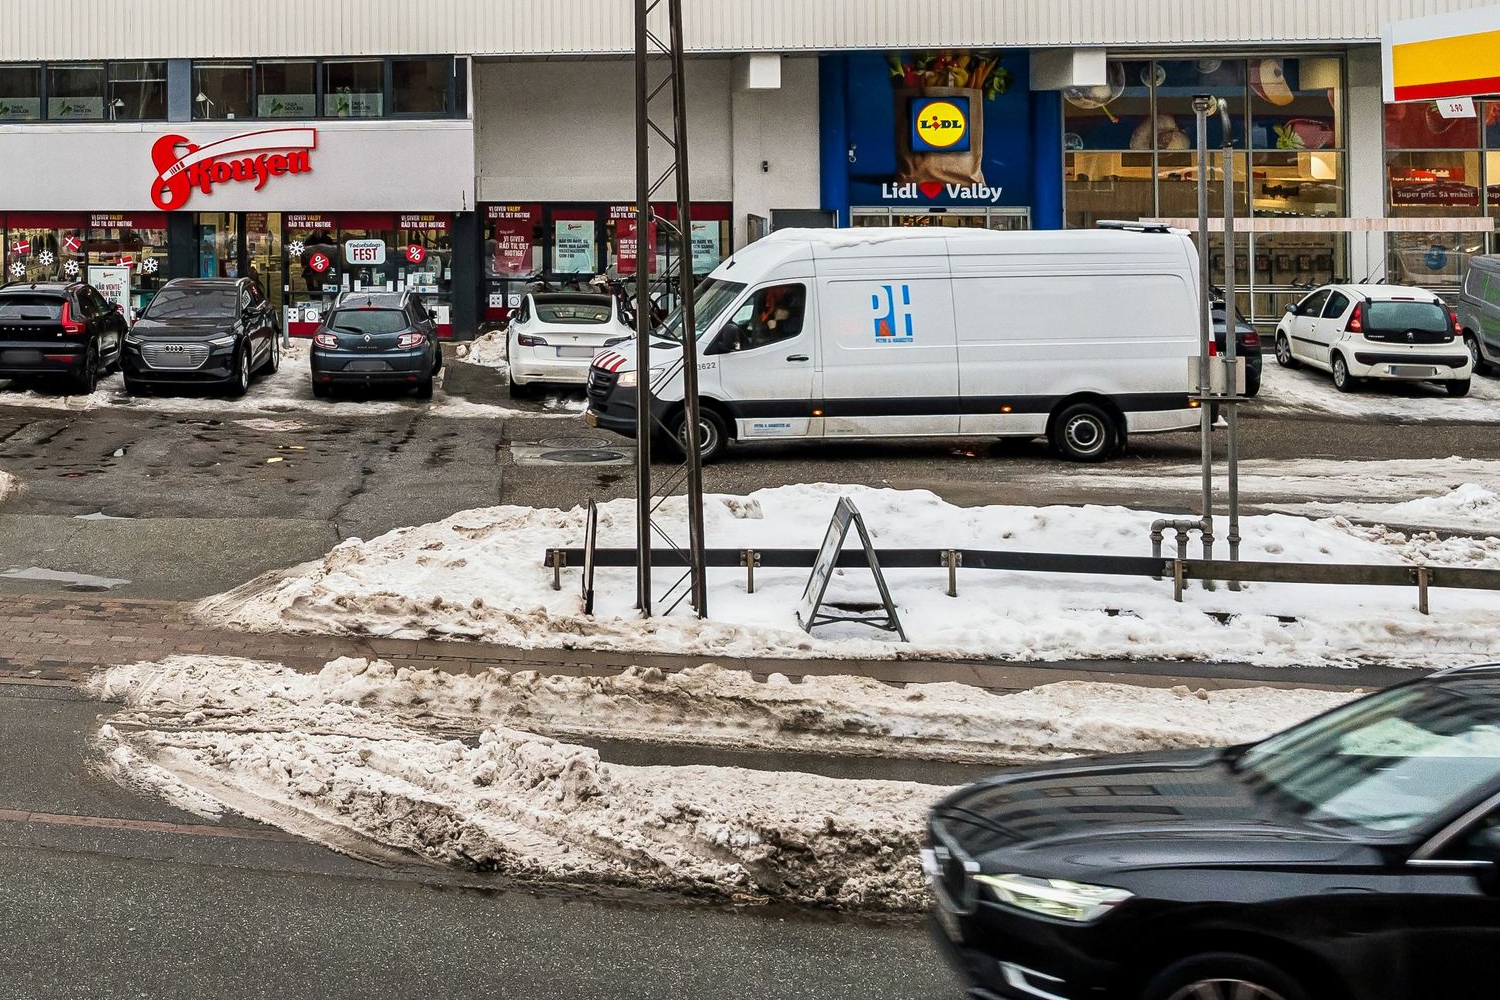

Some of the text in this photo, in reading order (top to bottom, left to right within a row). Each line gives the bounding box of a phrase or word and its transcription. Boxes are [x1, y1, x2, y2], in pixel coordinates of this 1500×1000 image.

[151, 134, 312, 211] Skousen
[882, 182, 1003, 203] Lidl Valby
[1397, 190, 1419, 198] Super
[1450, 190, 1474, 198] enkelt
[353, 248, 377, 260] FEST
